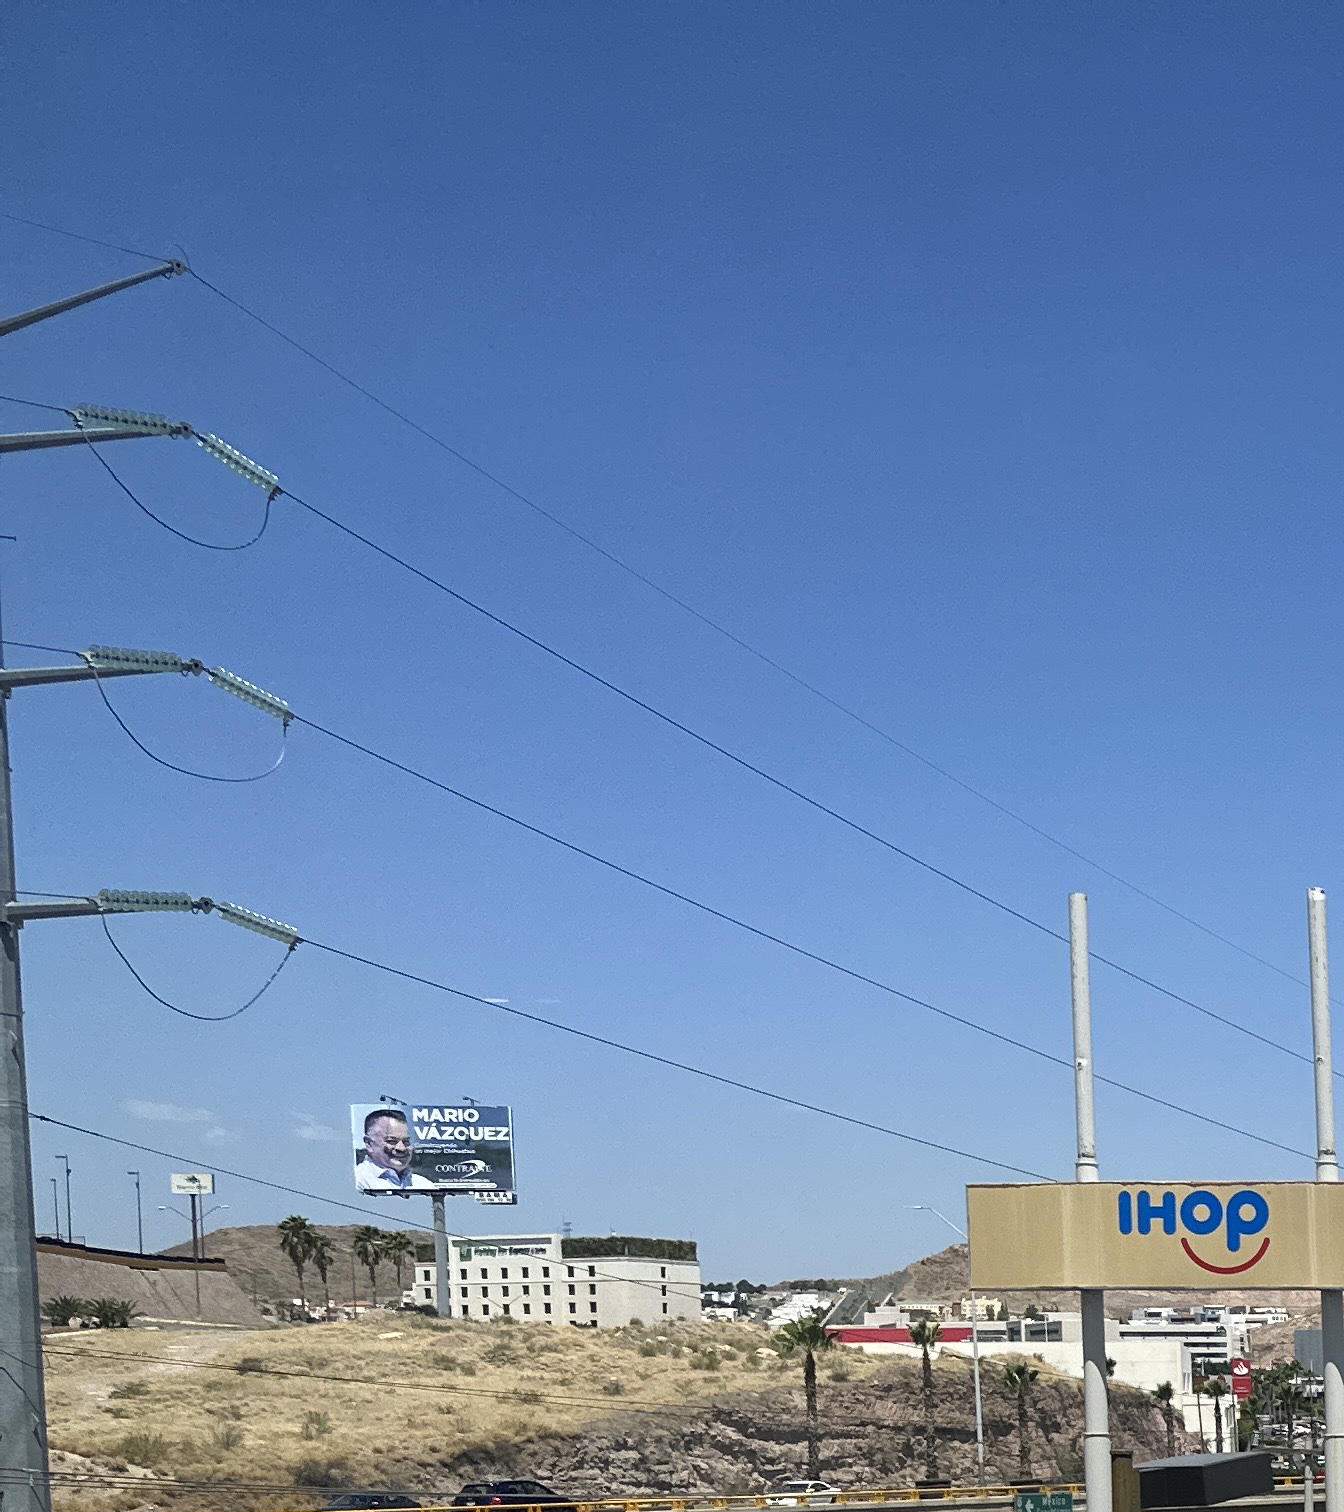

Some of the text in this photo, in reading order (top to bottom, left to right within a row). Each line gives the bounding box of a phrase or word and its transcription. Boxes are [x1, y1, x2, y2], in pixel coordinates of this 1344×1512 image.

[412, 1108, 480, 1123] MARIO
[413, 1123, 510, 1141] VÁZQUEZ
[1117, 1189, 1270, 1253] IHOP
